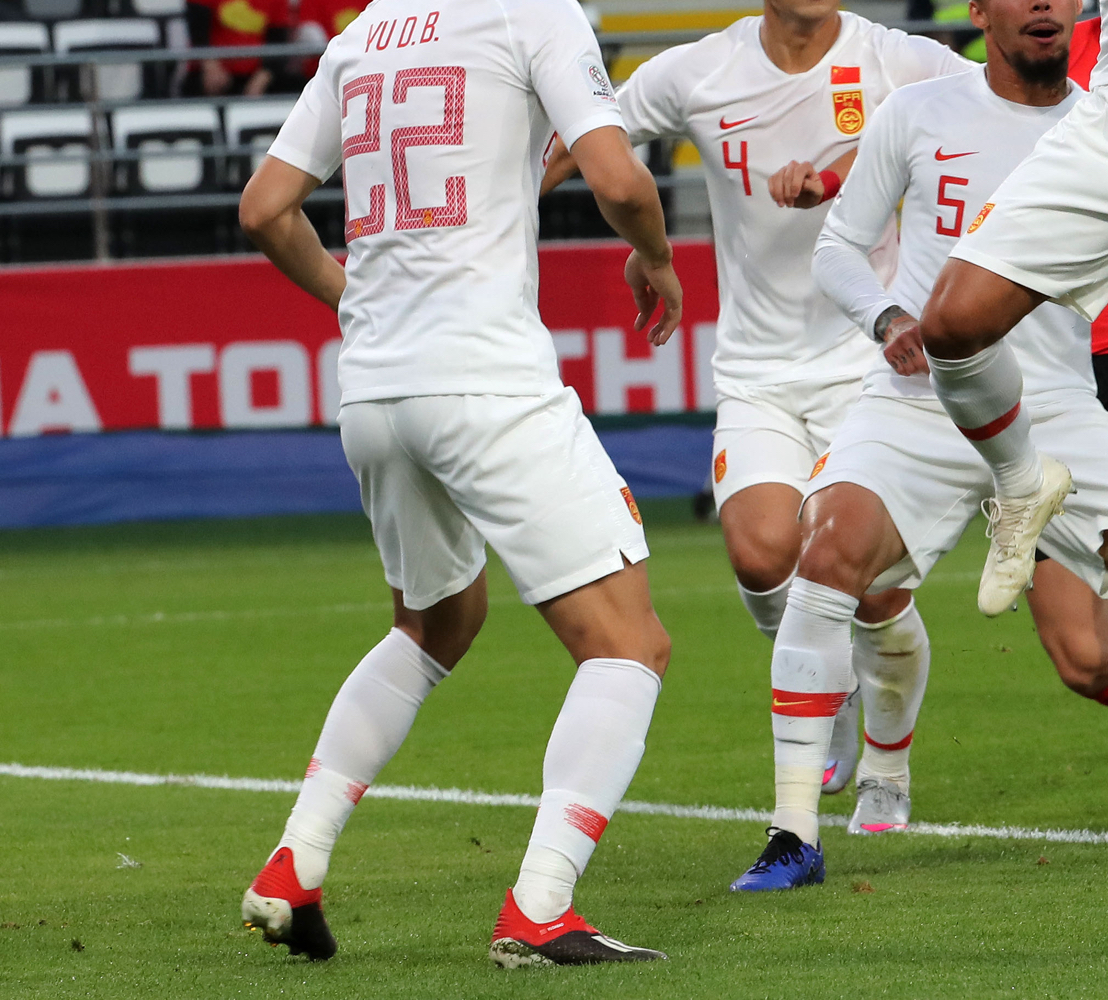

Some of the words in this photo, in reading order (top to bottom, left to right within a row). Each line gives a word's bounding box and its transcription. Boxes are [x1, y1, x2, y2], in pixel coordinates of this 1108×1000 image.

[365, 18, 397, 53] YU
[397, 10, 440, 48] D.B.
[834, 92, 861, 104] CFA
[342, 66, 468, 244] 22
[722, 141, 752, 196] 4
[936, 175, 969, 237] 5
